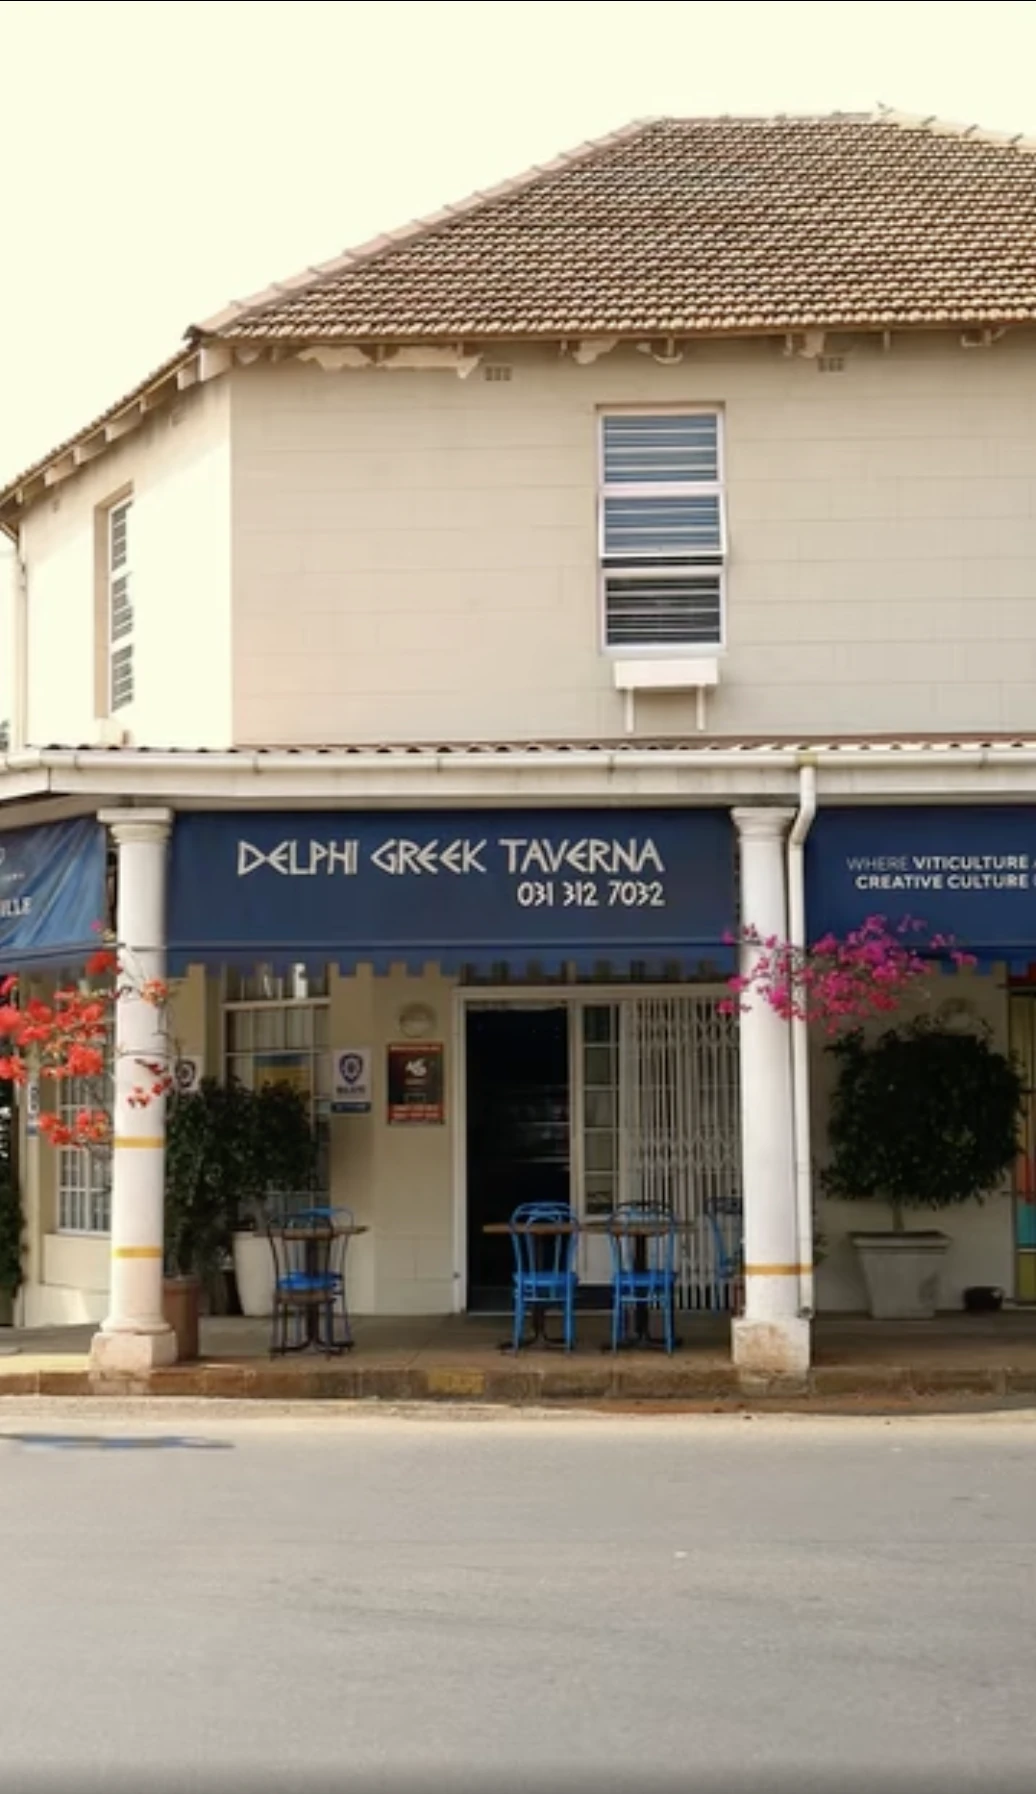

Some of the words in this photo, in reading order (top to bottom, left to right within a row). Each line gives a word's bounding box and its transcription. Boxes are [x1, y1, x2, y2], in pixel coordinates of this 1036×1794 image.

[236, 839, 359, 876] DELPHI
[370, 838, 487, 875] GREEK
[497, 837, 666, 875] TAVERNA
[846, 856, 909, 872] WHERE
[912, 855, 1029, 871] VITICULTURE
[855, 874, 943, 890] CREATIVE
[947, 874, 1029, 890] CULTURE
[517, 880, 554, 907] 031
[563, 880, 598, 907] 312
[608, 880, 666, 907] 7032
[0, 897, 32, 917] ILLE
